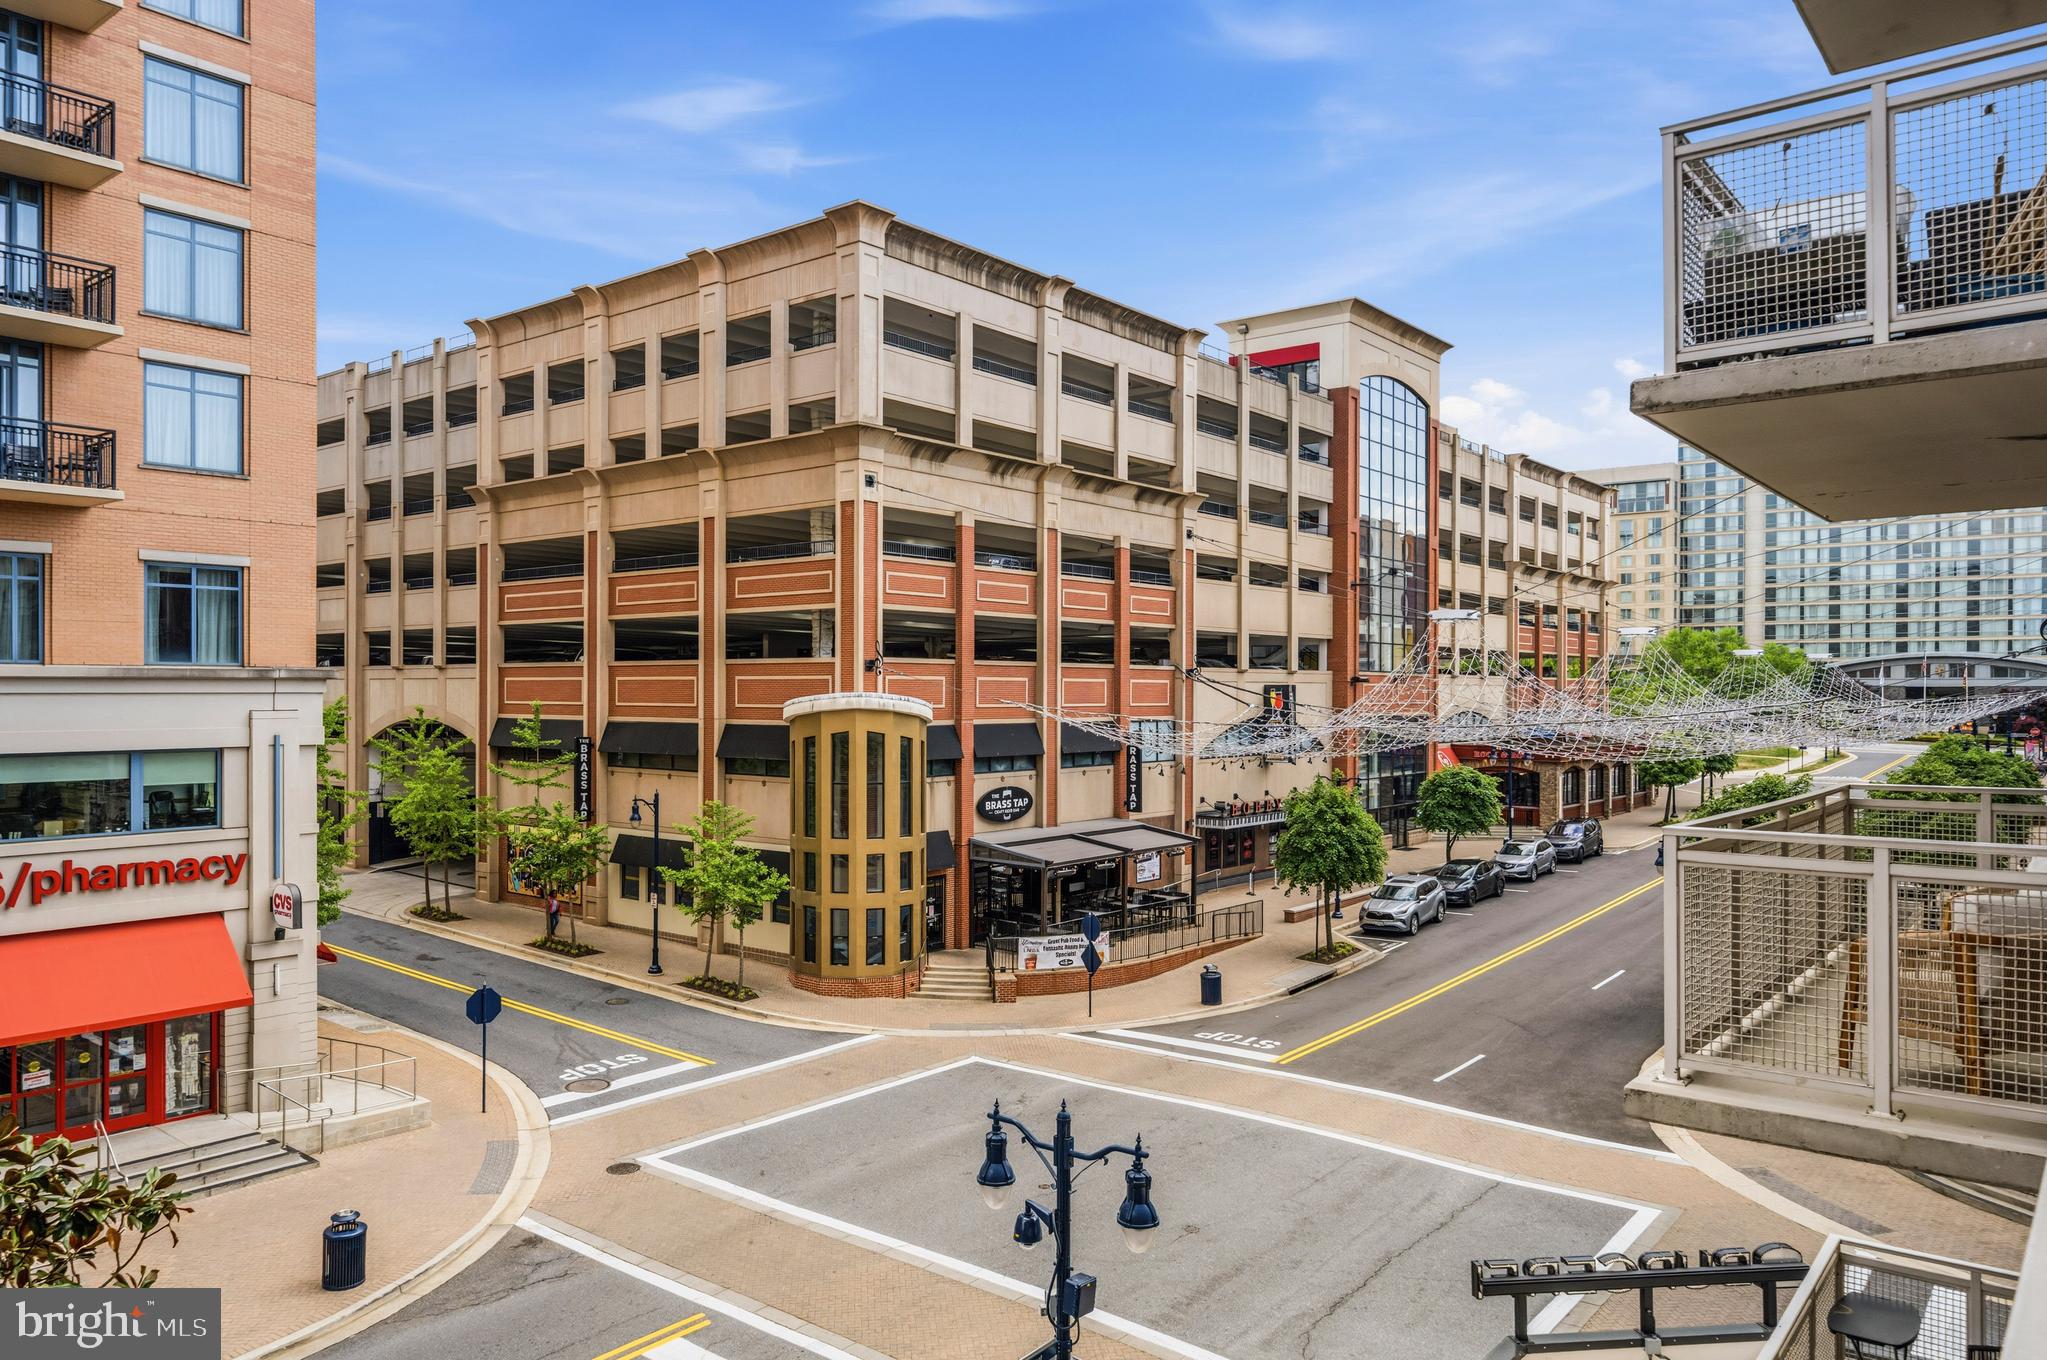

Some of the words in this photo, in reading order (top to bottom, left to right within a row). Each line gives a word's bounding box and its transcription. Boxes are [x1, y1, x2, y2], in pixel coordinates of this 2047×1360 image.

[580, 744, 589, 790] BRASS
[580, 792, 588, 819] TAP
[986, 800, 1012, 810] BRASS
[1013, 798, 1028, 807] TAP
[1129, 784, 1137, 810] TAP
[0, 853, 248, 909] /pharmacy
[273, 893, 292, 911] CVS
[1194, 1032, 1281, 1049] STOP
[559, 1054, 648, 1080] STOP
